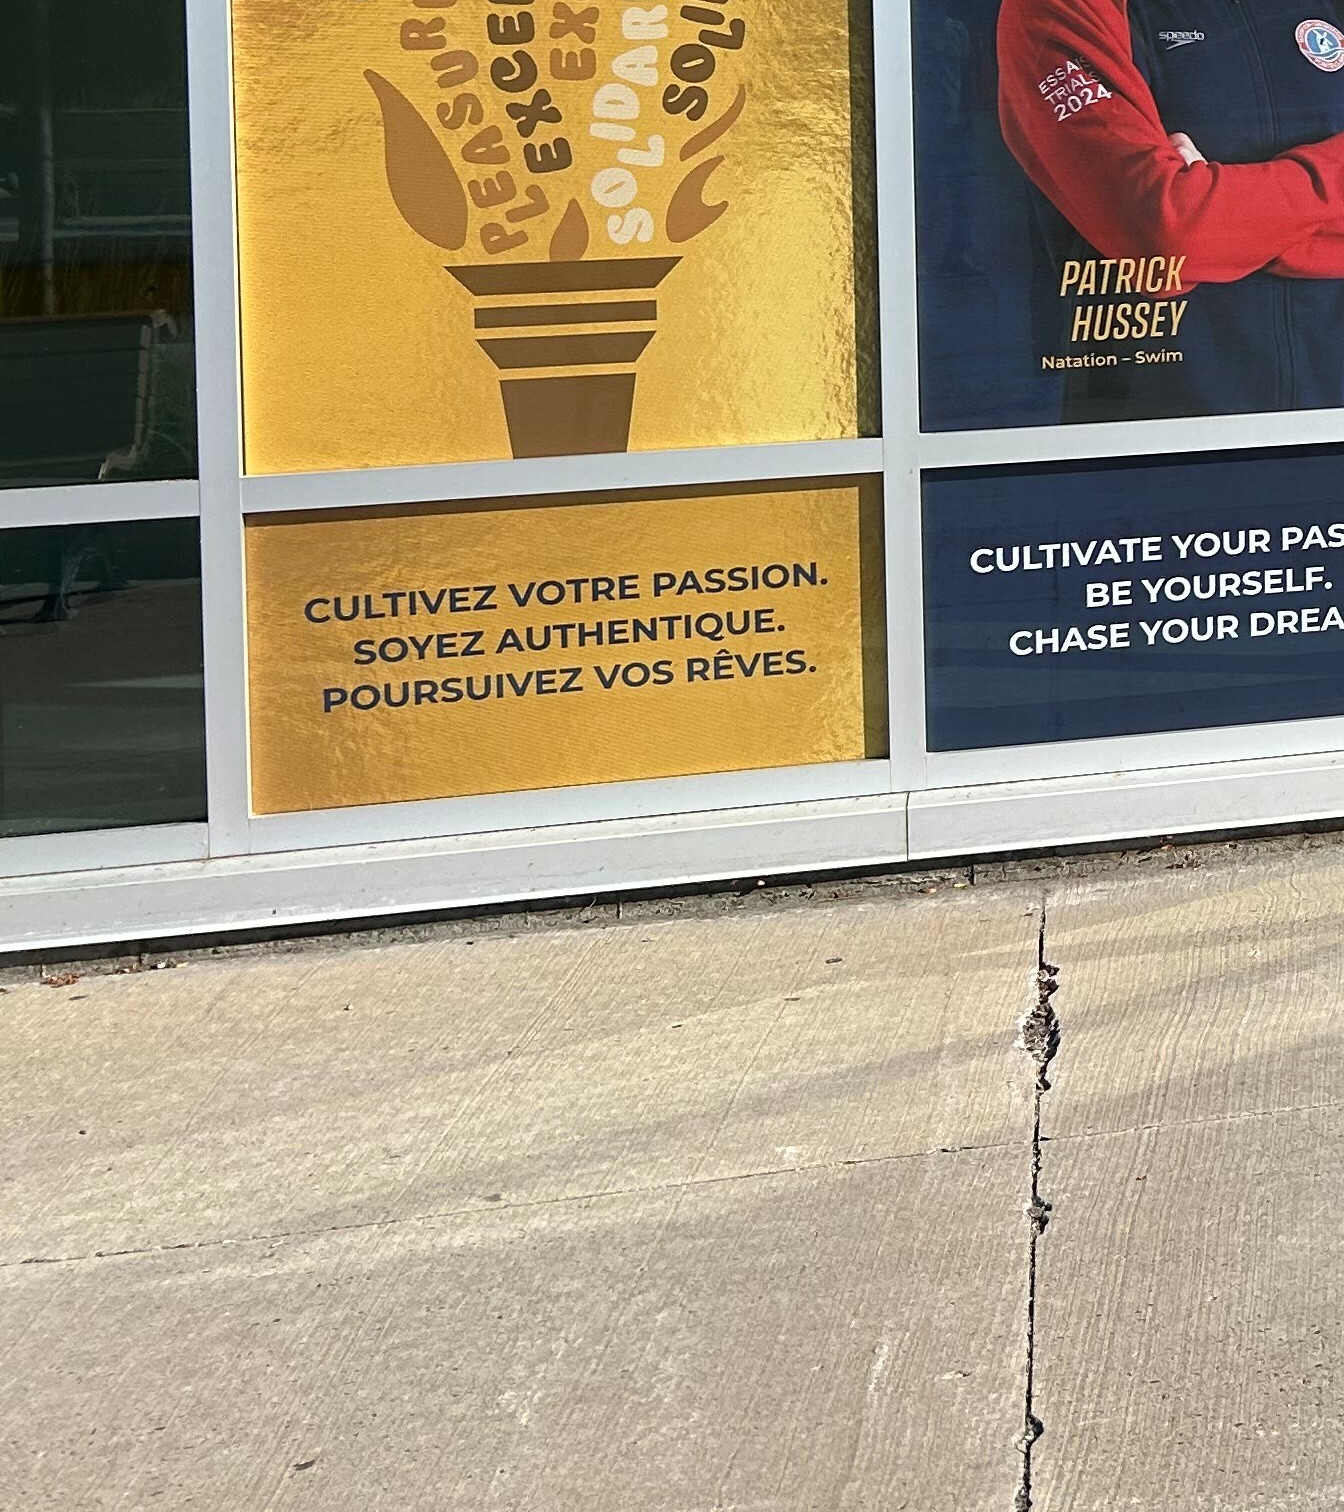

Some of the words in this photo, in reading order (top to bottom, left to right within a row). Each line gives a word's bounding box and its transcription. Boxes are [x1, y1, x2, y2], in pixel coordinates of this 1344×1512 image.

[1159, 30, 1205, 42] speedo
[1038, 56, 1091, 95] ESSAIS
[1045, 70, 1101, 106] TRIALS
[1054, 83, 1113, 122] 2024
[1060, 256, 1187, 296] PATRICK
[1071, 299, 1188, 342] HUSSEY
[1042, 351, 1118, 371] Natation
[1135, 347, 1183, 366] Swim
[970, 536, 1162, 574] CULTIVATE
[1171, 527, 1270, 559] YOUR
[305, 585, 497, 624] CULTIVEZ
[509, 573, 640, 607] VOTRE
[653, 560, 829, 597] PASSION.
[1086, 581, 1132, 609] BE
[1142, 565, 1333, 603] YOURSELF.
[354, 631, 484, 665] SOYEZ
[496, 607, 785, 654] AUTHENTIQUE.
[1009, 623, 1130, 657] CHASE
[1139, 616, 1238, 646] YOUR
[323, 668, 582, 713] POURSUIVEZ
[594, 660, 674, 692] VOS
[685, 649, 817, 682] RÊVES.
